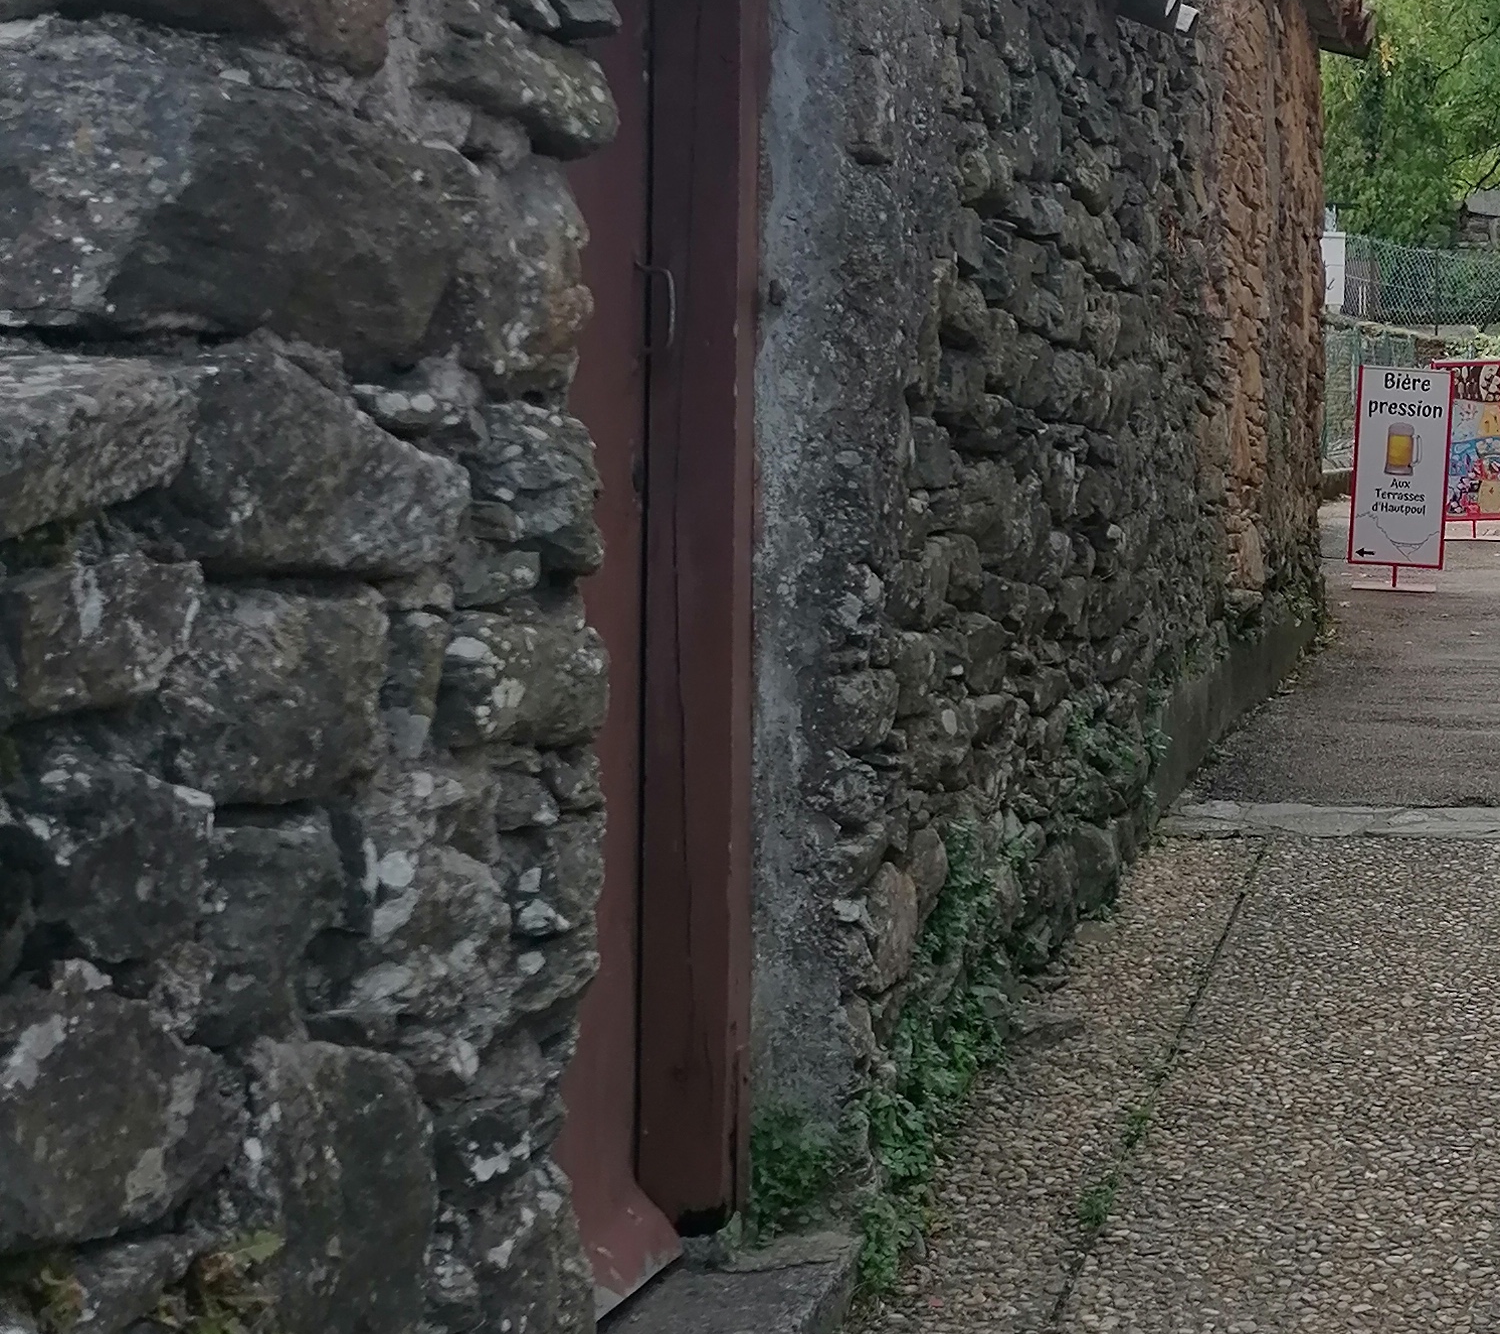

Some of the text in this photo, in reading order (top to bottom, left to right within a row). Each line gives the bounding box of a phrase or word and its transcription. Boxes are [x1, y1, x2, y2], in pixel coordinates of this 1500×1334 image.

[1384, 372, 1431, 392] Bière
[1368, 399, 1443, 419] pression
[1390, 478, 1410, 490] Aux
[1375, 488, 1426, 502] Terrasses
[1371, 502, 1426, 516] d'Hautpoul
